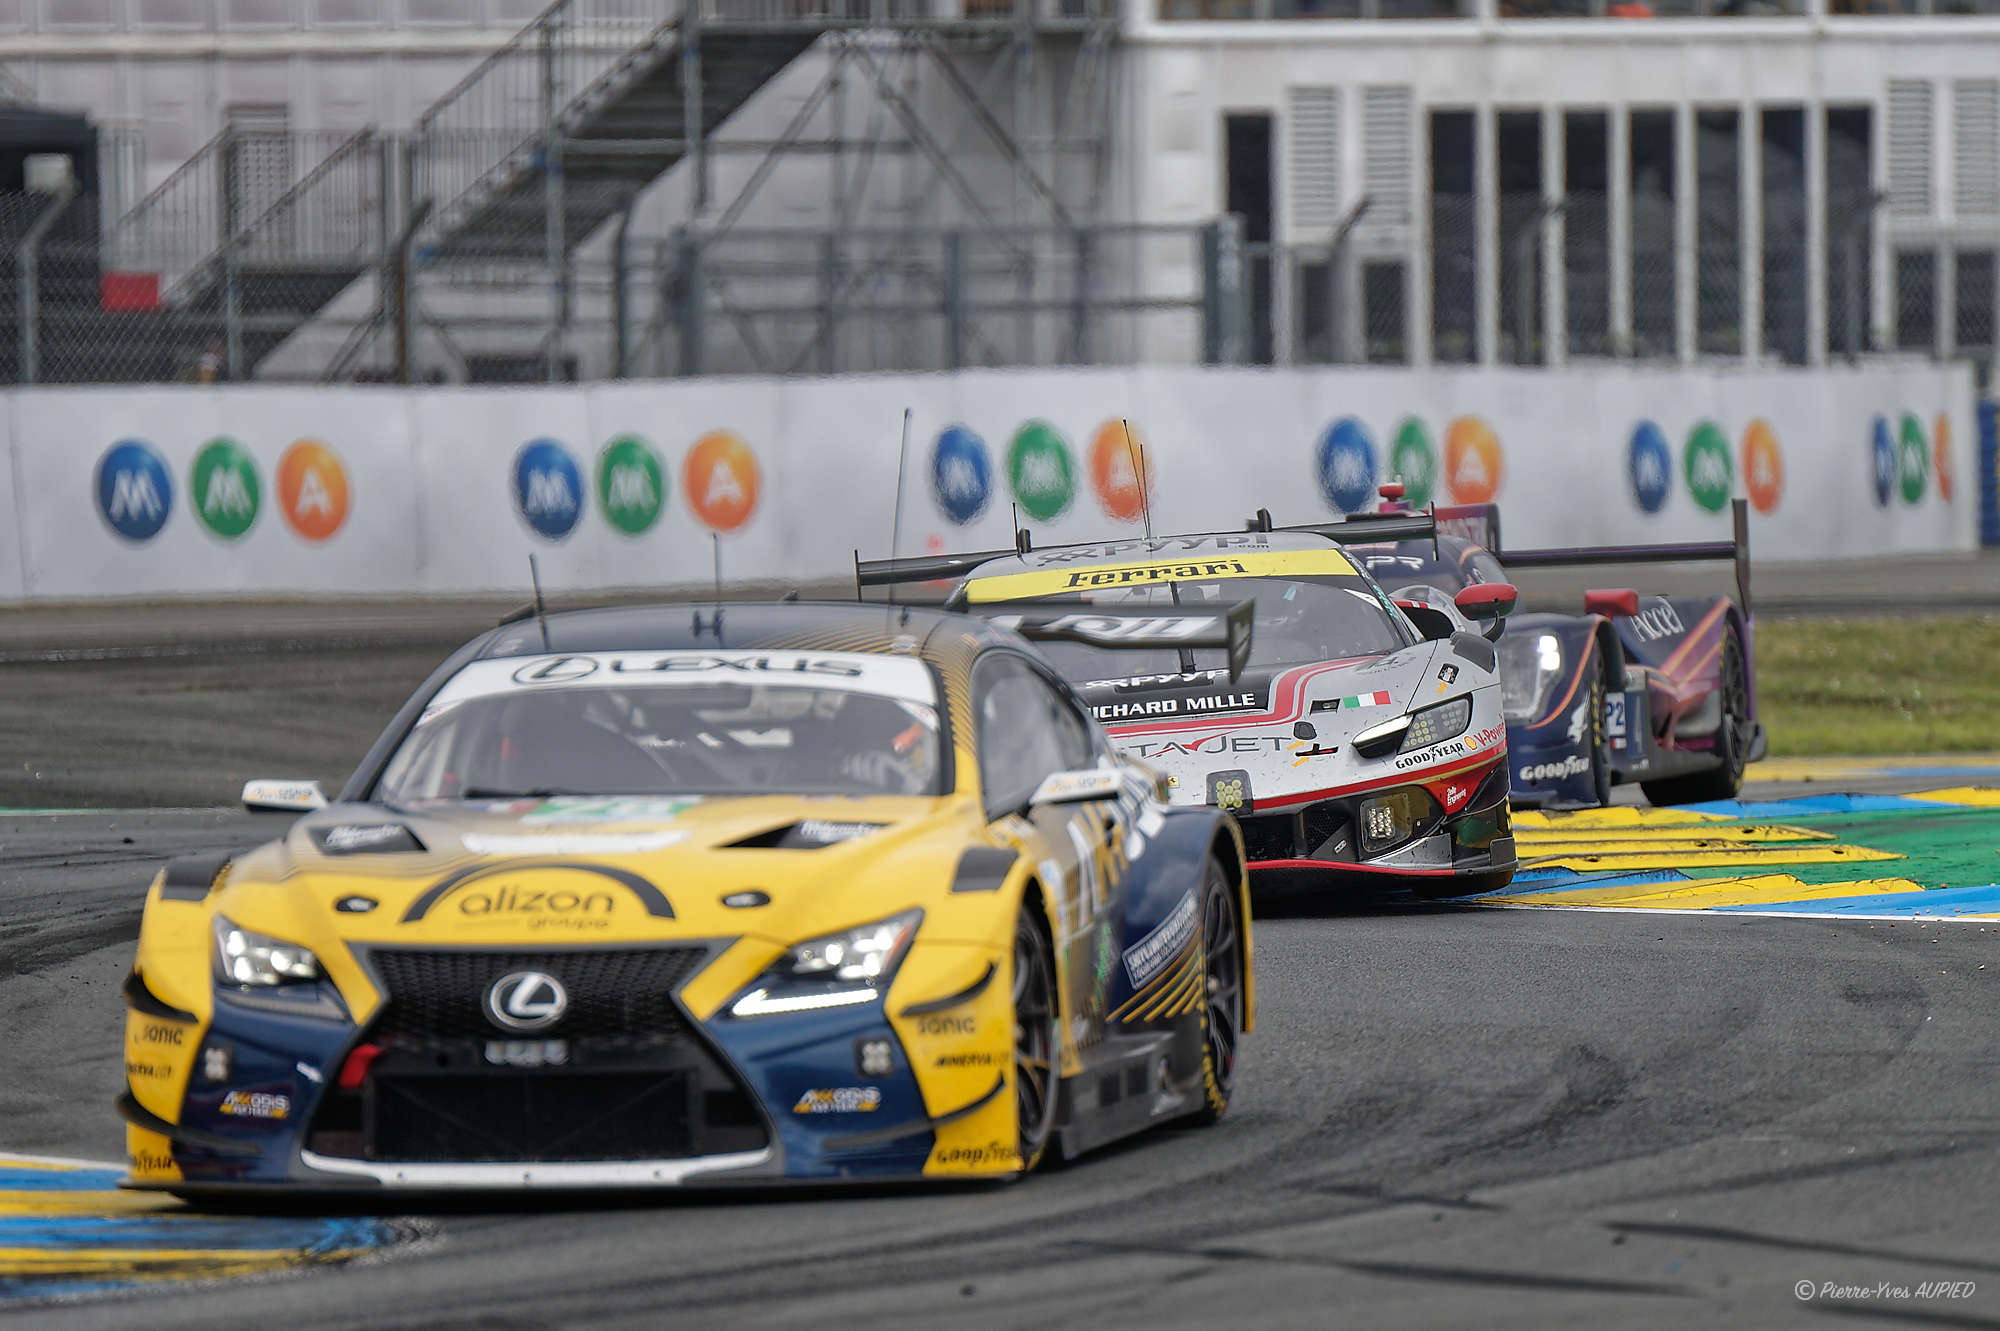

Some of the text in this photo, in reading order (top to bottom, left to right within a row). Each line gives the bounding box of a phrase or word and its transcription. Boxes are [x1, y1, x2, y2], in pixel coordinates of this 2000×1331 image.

[1063, 560, 1248, 587] Ferrari
[609, 655, 862, 677] LEXUS
[1131, 669, 1230, 687] pyyp
[1186, 693, 1256, 710] MILLE
[1128, 735, 1292, 758] TAJET
[1395, 743, 1465, 769] GOODYEAR
[459, 886, 615, 915] alizon
